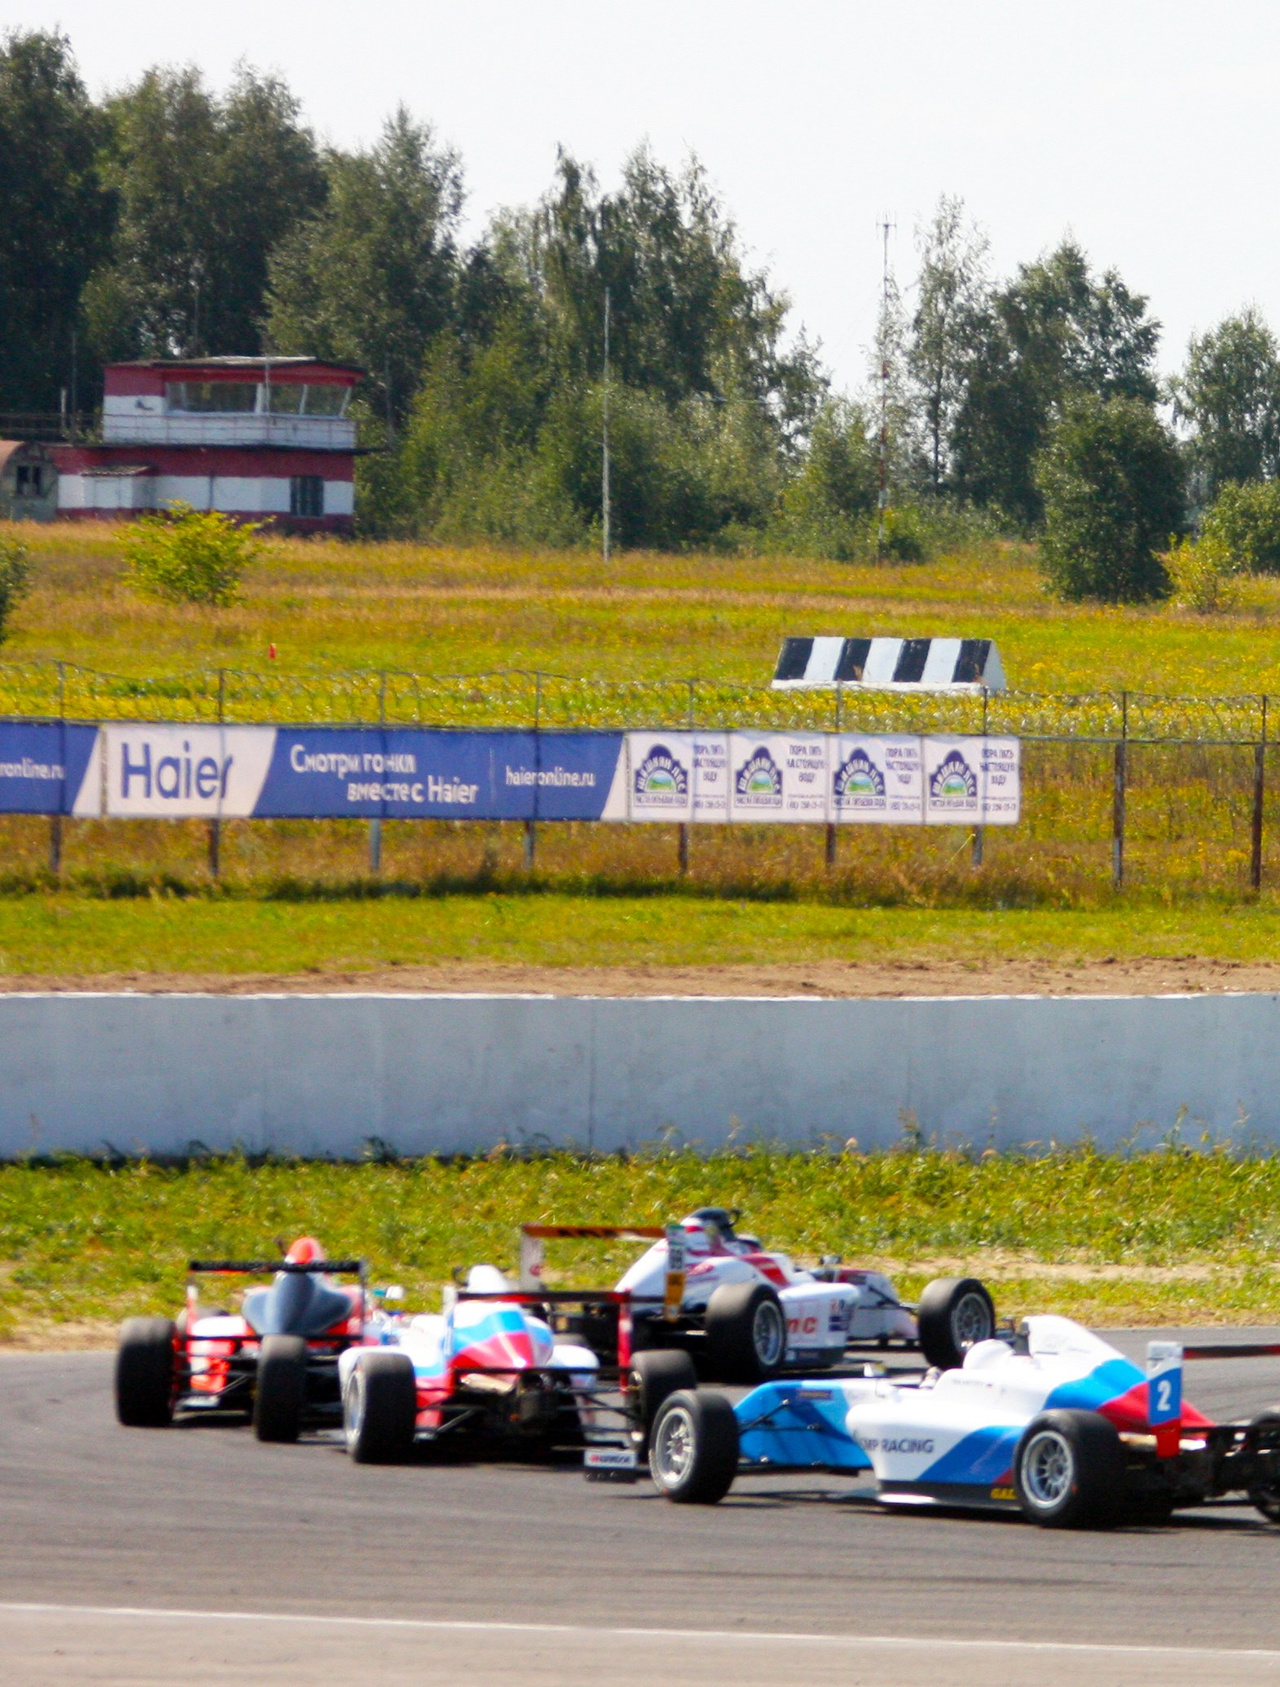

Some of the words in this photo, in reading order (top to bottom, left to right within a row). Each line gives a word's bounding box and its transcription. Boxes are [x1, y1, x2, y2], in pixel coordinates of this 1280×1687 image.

[121, 740, 233, 799] Haier
[427, 775, 479, 804] Haier
[1157, 1379, 1172, 1412] 2
[881, 1438, 935, 1454] RACING
